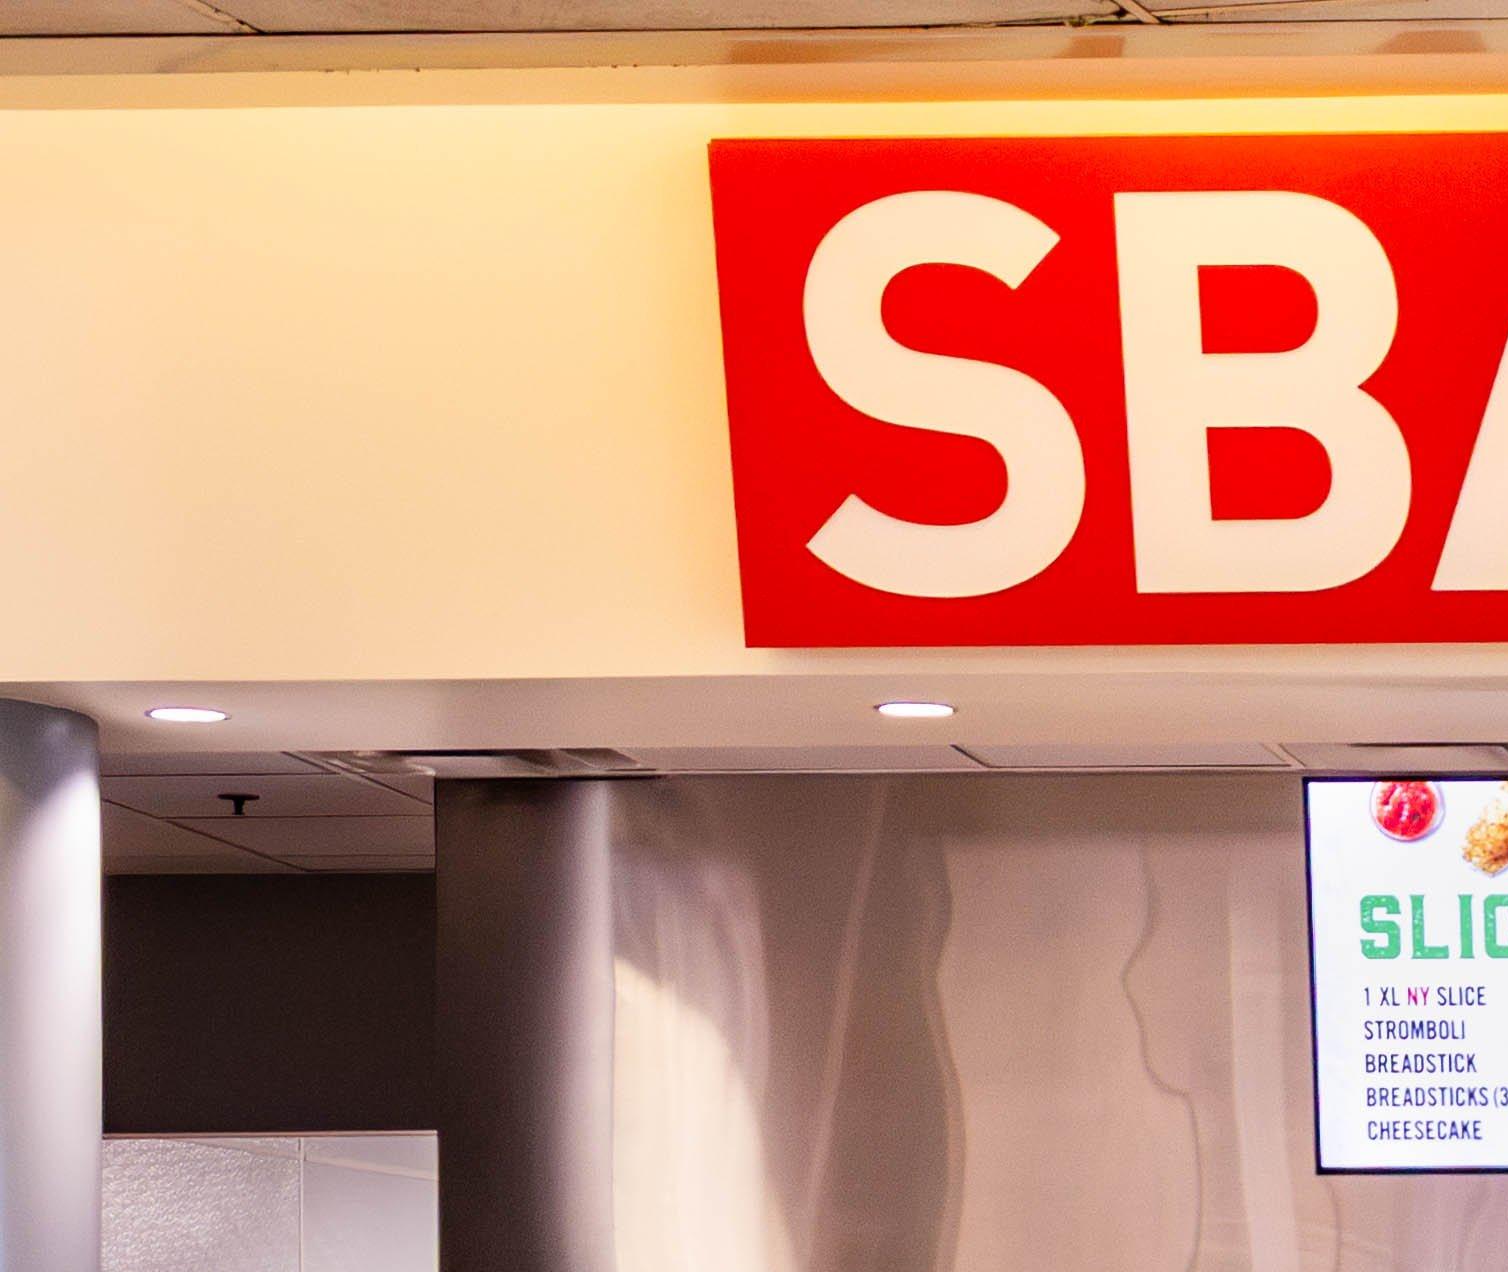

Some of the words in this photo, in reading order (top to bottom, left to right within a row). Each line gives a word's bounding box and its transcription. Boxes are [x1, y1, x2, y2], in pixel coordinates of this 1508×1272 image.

[1364, 986, 1371, 1006] 1
[1379, 986, 1400, 1006] XL
[1407, 986, 1429, 1006] NY
[1437, 986, 1487, 1006] SLICE
[1364, 1020, 1466, 1040] STROMBOLI
[1365, 1053, 1477, 1073] BREADSTICK
[1366, 1087, 1489, 1107] BREADSTICKS
[1367, 1120, 1483, 1141] CHEESECAKE
